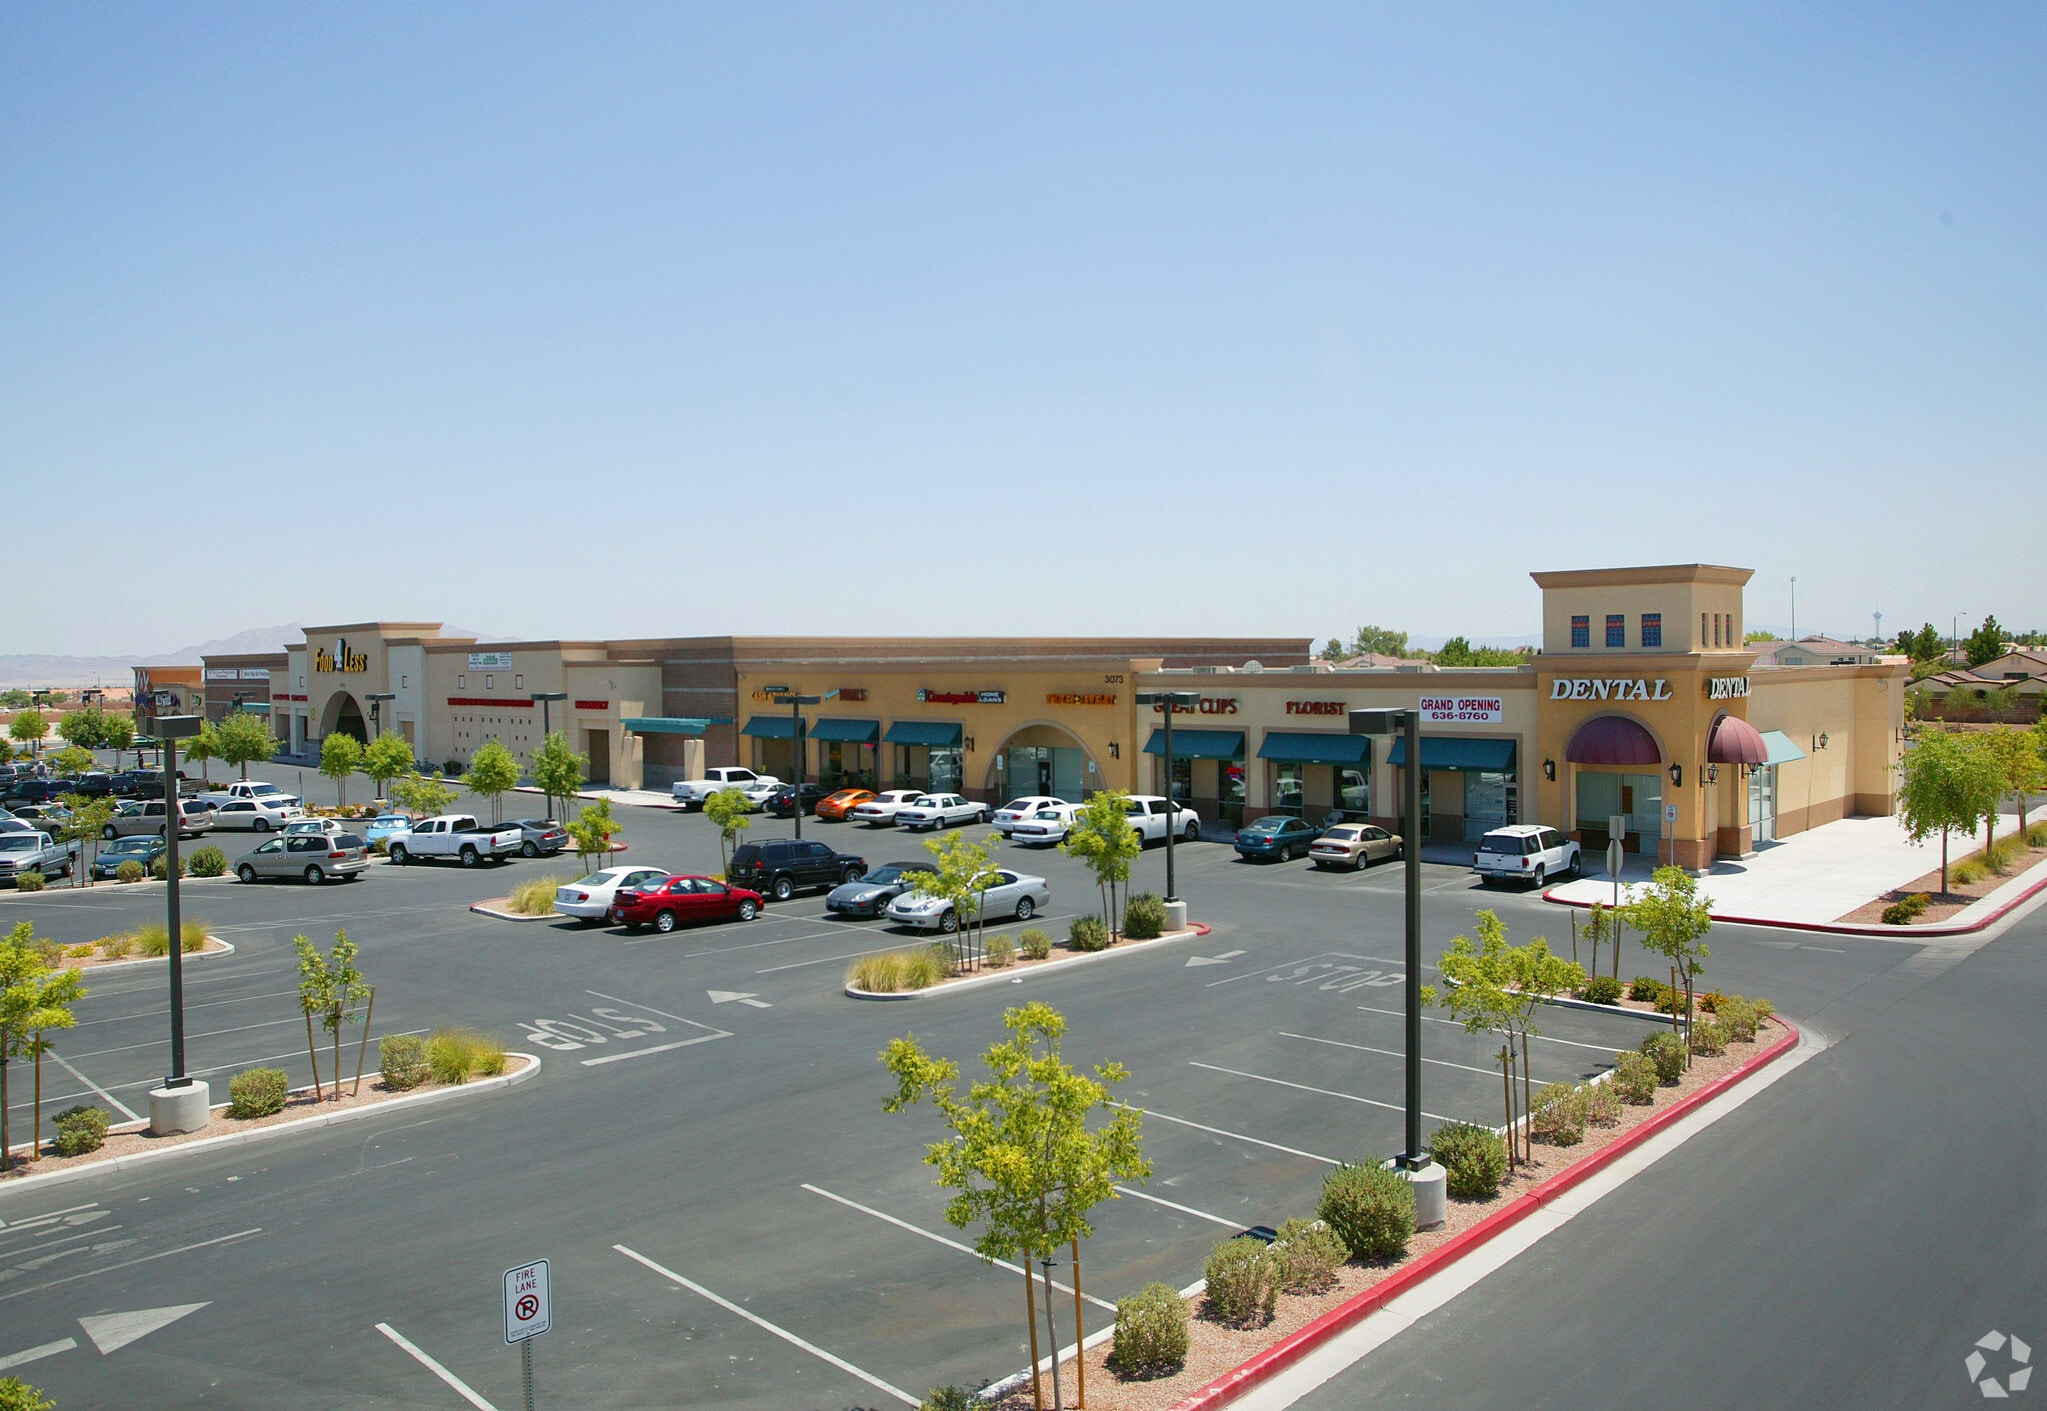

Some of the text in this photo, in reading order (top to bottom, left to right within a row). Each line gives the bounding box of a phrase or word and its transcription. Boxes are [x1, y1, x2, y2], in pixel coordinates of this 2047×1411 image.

[334, 637, 346, 672] 4
[1104, 675, 1124, 684] 3073
[1549, 679, 1673, 700] DENTAL
[1199, 698, 1238, 715] CLIPS
[1286, 701, 1347, 716] FLORIST
[1421, 699, 1500, 712] GRAND OPENING
[1431, 711, 1489, 720] 636-8760
[516, 1008, 666, 1050] STOP
[516, 1268, 536, 1282] FIRE
[515, 1279, 537, 1294] LANE
